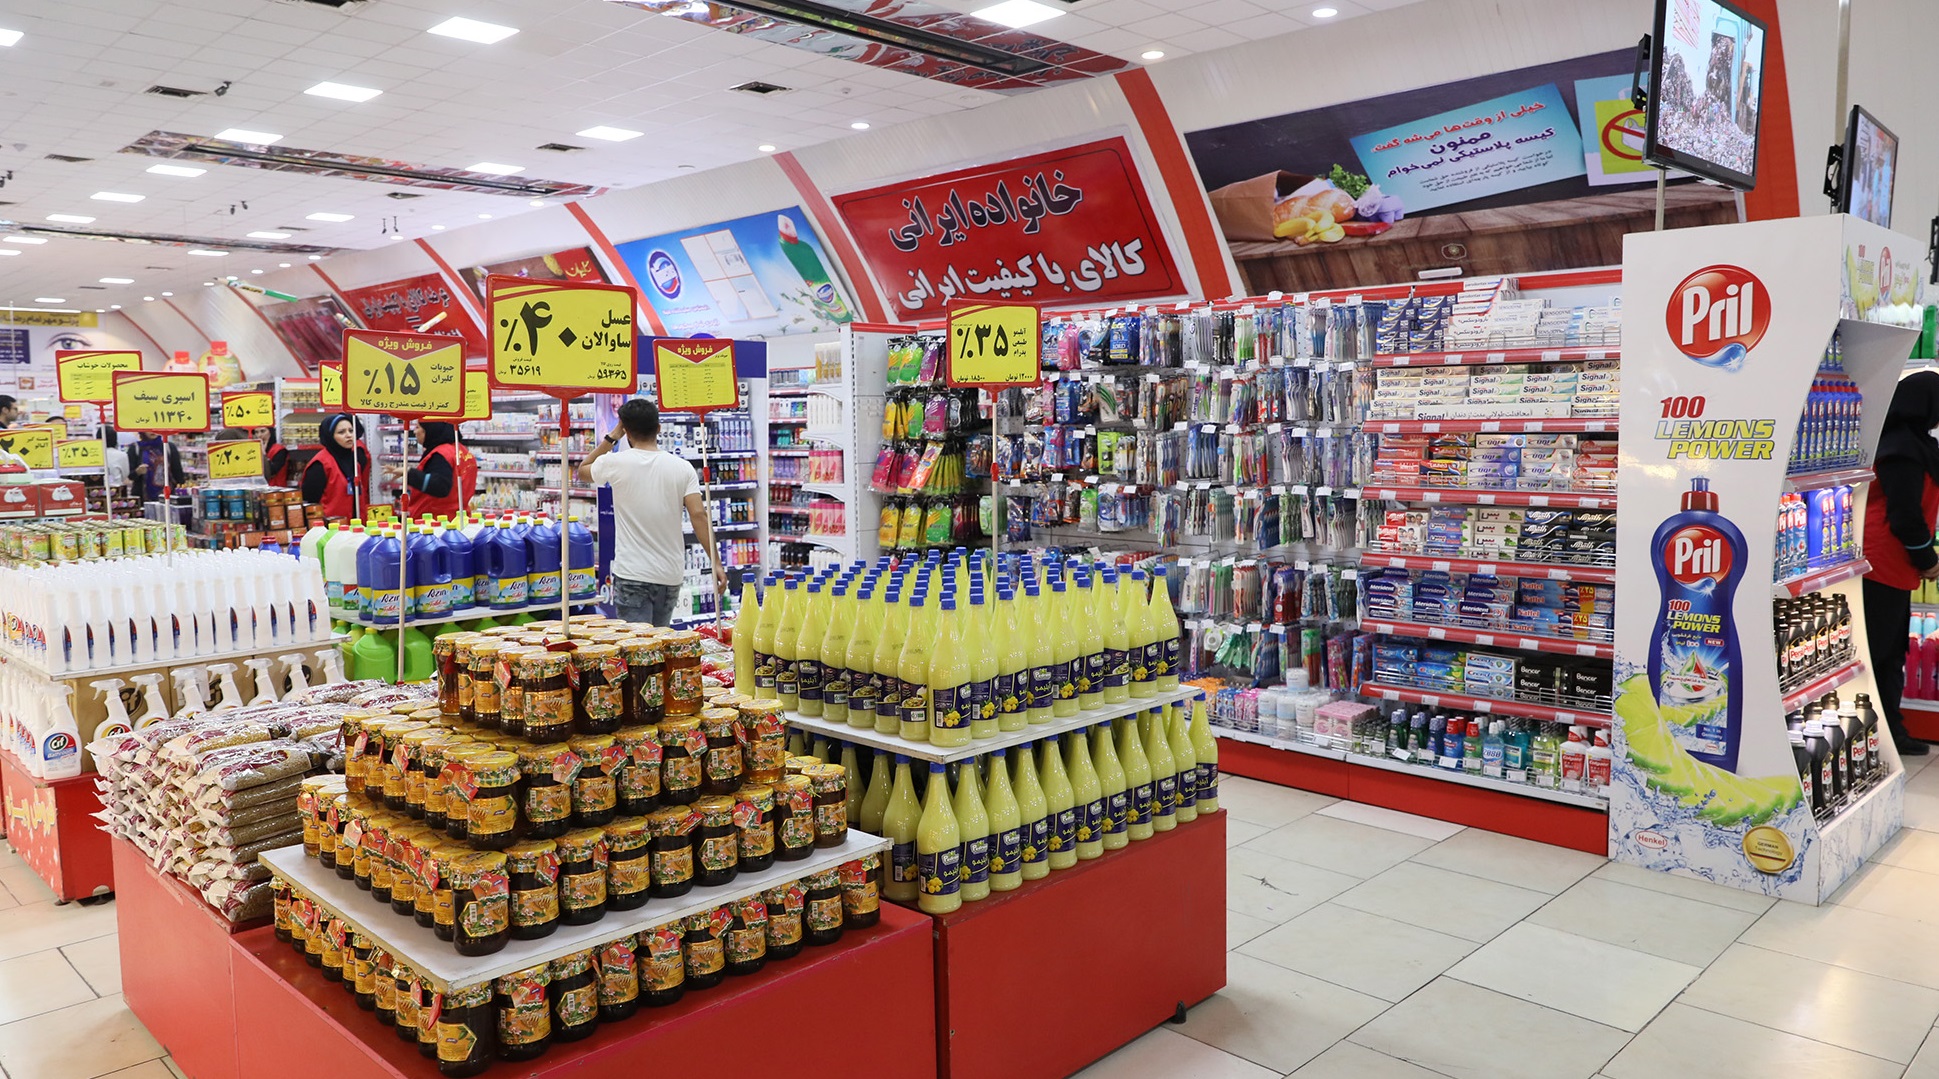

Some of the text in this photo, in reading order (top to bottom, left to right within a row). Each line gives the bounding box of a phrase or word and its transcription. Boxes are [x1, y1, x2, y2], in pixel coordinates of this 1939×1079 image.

[1510, 101, 1545, 118] خیلی
[1496, 111, 1506, 123] از
[1514, 128, 1556, 144] کیسه
[1430, 131, 1492, 154] ممنون
[1449, 140, 1512, 164] پلاستیکی
[888, 170, 1083, 252] خانواده ایرانی
[898, 238, 1146, 309] کالای با کیفیت ایرانی
[602, 310, 631, 328] عسل
[1681, 282, 1754, 346] Pril
[378, 337, 432, 350] فروش ویژه
[582, 331, 631, 352] ساوالان
[678, 344, 712, 355] فروش ویژه
[430, 364, 454, 372] حبوبات
[510, 365, 542, 376] ۳۵۶۱۹
[1426, 367, 1445, 376] Signal
[1588, 362, 1612, 370] Signal
[1424, 378, 1444, 386] Signal
[1474, 377, 1496, 386] Signal
[1582, 373, 1606, 381] Signal
[1472, 387, 1494, 395] Signal
[1580, 384, 1604, 392] Signal
[134, 391, 194, 405] اسپری سیف
[374, 400, 388, 408] روی
[390, 400, 410, 408] مندرج
[436, 401, 450, 410] کمتر
[1660, 396, 1706, 418] 100
[154, 410, 192, 422] ۱۱۳۴۰
[1654, 419, 1776, 440] LEMONS
[1668, 441, 1774, 460] POWER
[1674, 538, 1720, 574] Pril
[1668, 600, 1690, 612] 100
[1667, 612, 1721, 624] LEMONS
[1673, 621, 1720, 633] POWER
[1521, 666, 1540, 674] Bencer
[1520, 679, 1540, 688] Bencer
[1576, 673, 1597, 682] Bencer
[1576, 686, 1596, 694] Bencer
[52, 737, 65, 750] Cif
[1638, 835, 1664, 846] Henkel
[1758, 841, 1778, 849] GERMAN
[1755, 846, 1782, 856] Technology
